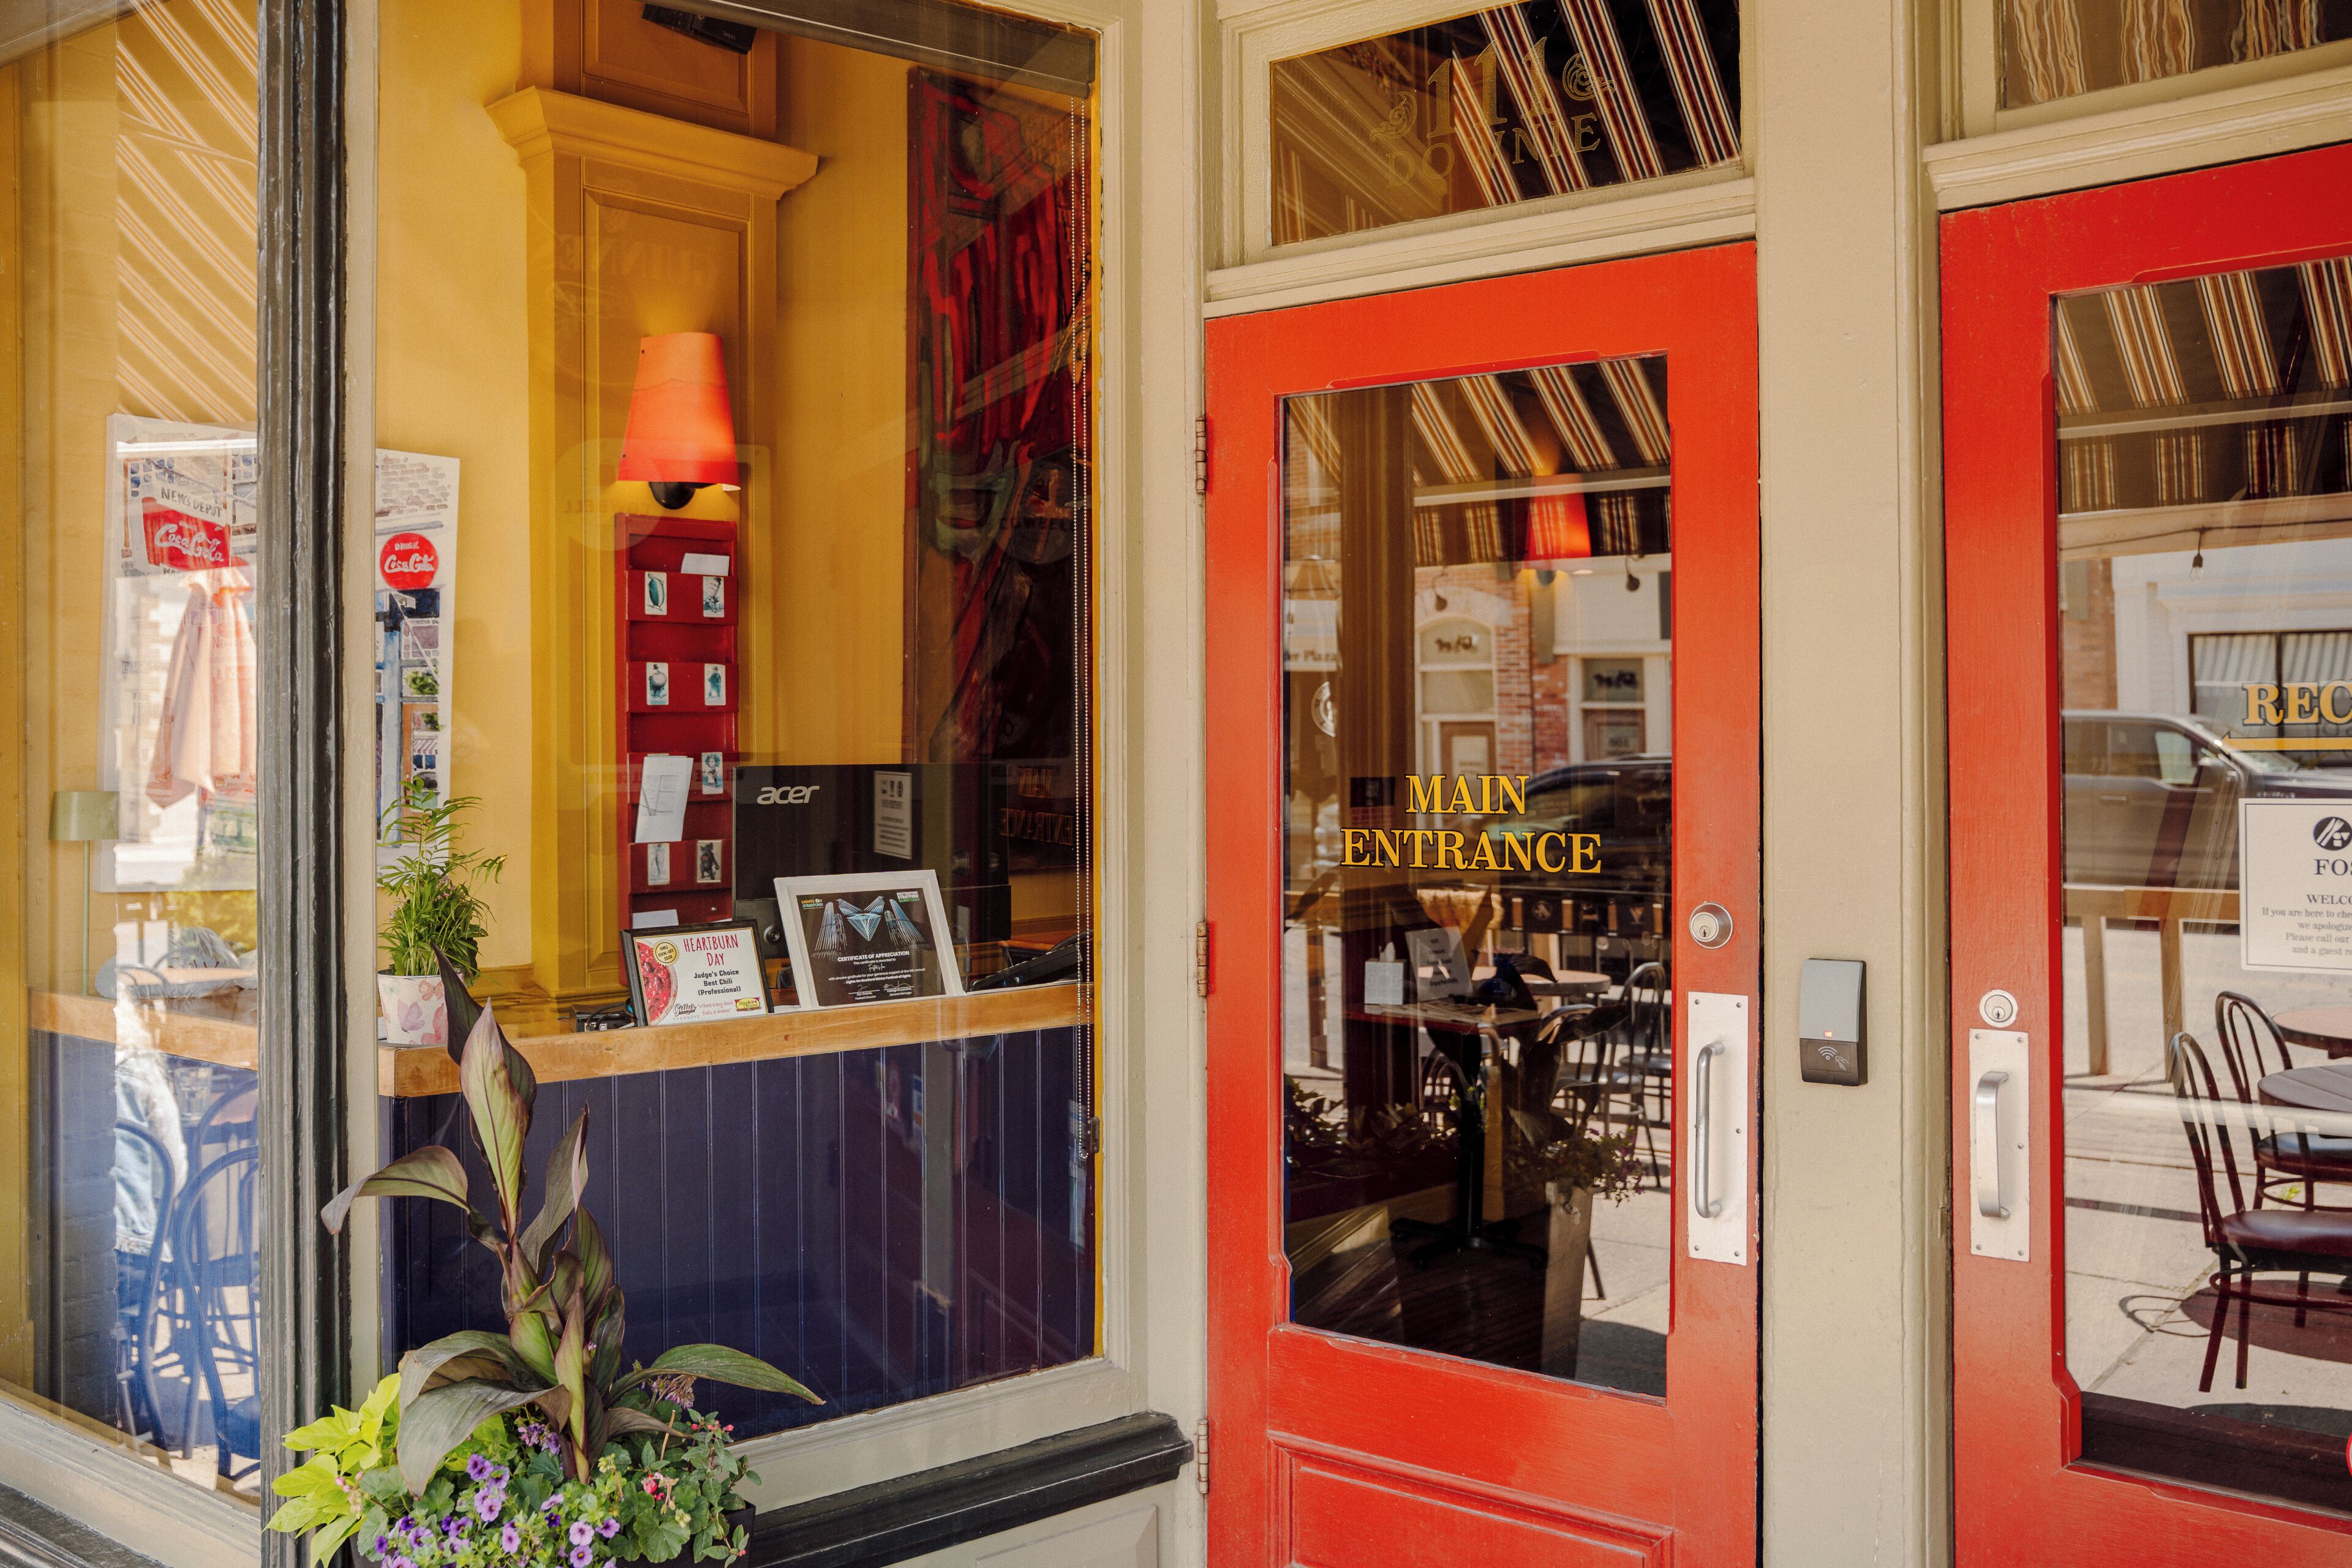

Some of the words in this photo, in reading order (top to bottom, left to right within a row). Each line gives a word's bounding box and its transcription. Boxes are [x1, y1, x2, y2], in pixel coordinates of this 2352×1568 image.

[1427, 37, 1553, 138] 111
[1388, 113, 1601, 189] DOWNIE
[161, 487, 191, 508] NEWS
[192, 499, 224, 518] DEPOT
[757, 785, 820, 805] acer
[1405, 774, 1529, 815] MAIN
[1340, 827, 1602, 873] ENTRANCE
[2314, 859, 2352, 876] FO
[2262, 907, 2269, 916] If
[2271, 909, 2286, 918] you
[2305, 908, 2323, 918] here
[2326, 910, 2334, 918] to
[683, 934, 739, 952] HEARTBURN
[2286, 932, 2313, 942] Please
[2316, 933, 2332, 943] call
[658, 948, 674, 957] COOK-OFF
[2292, 945, 2309, 954] and
[2318, 947, 2342, 956] guest
[706, 952, 725, 967] DAY
[694, 970, 717, 979] Judge's
[698, 986, 741, 996] (Professional)
